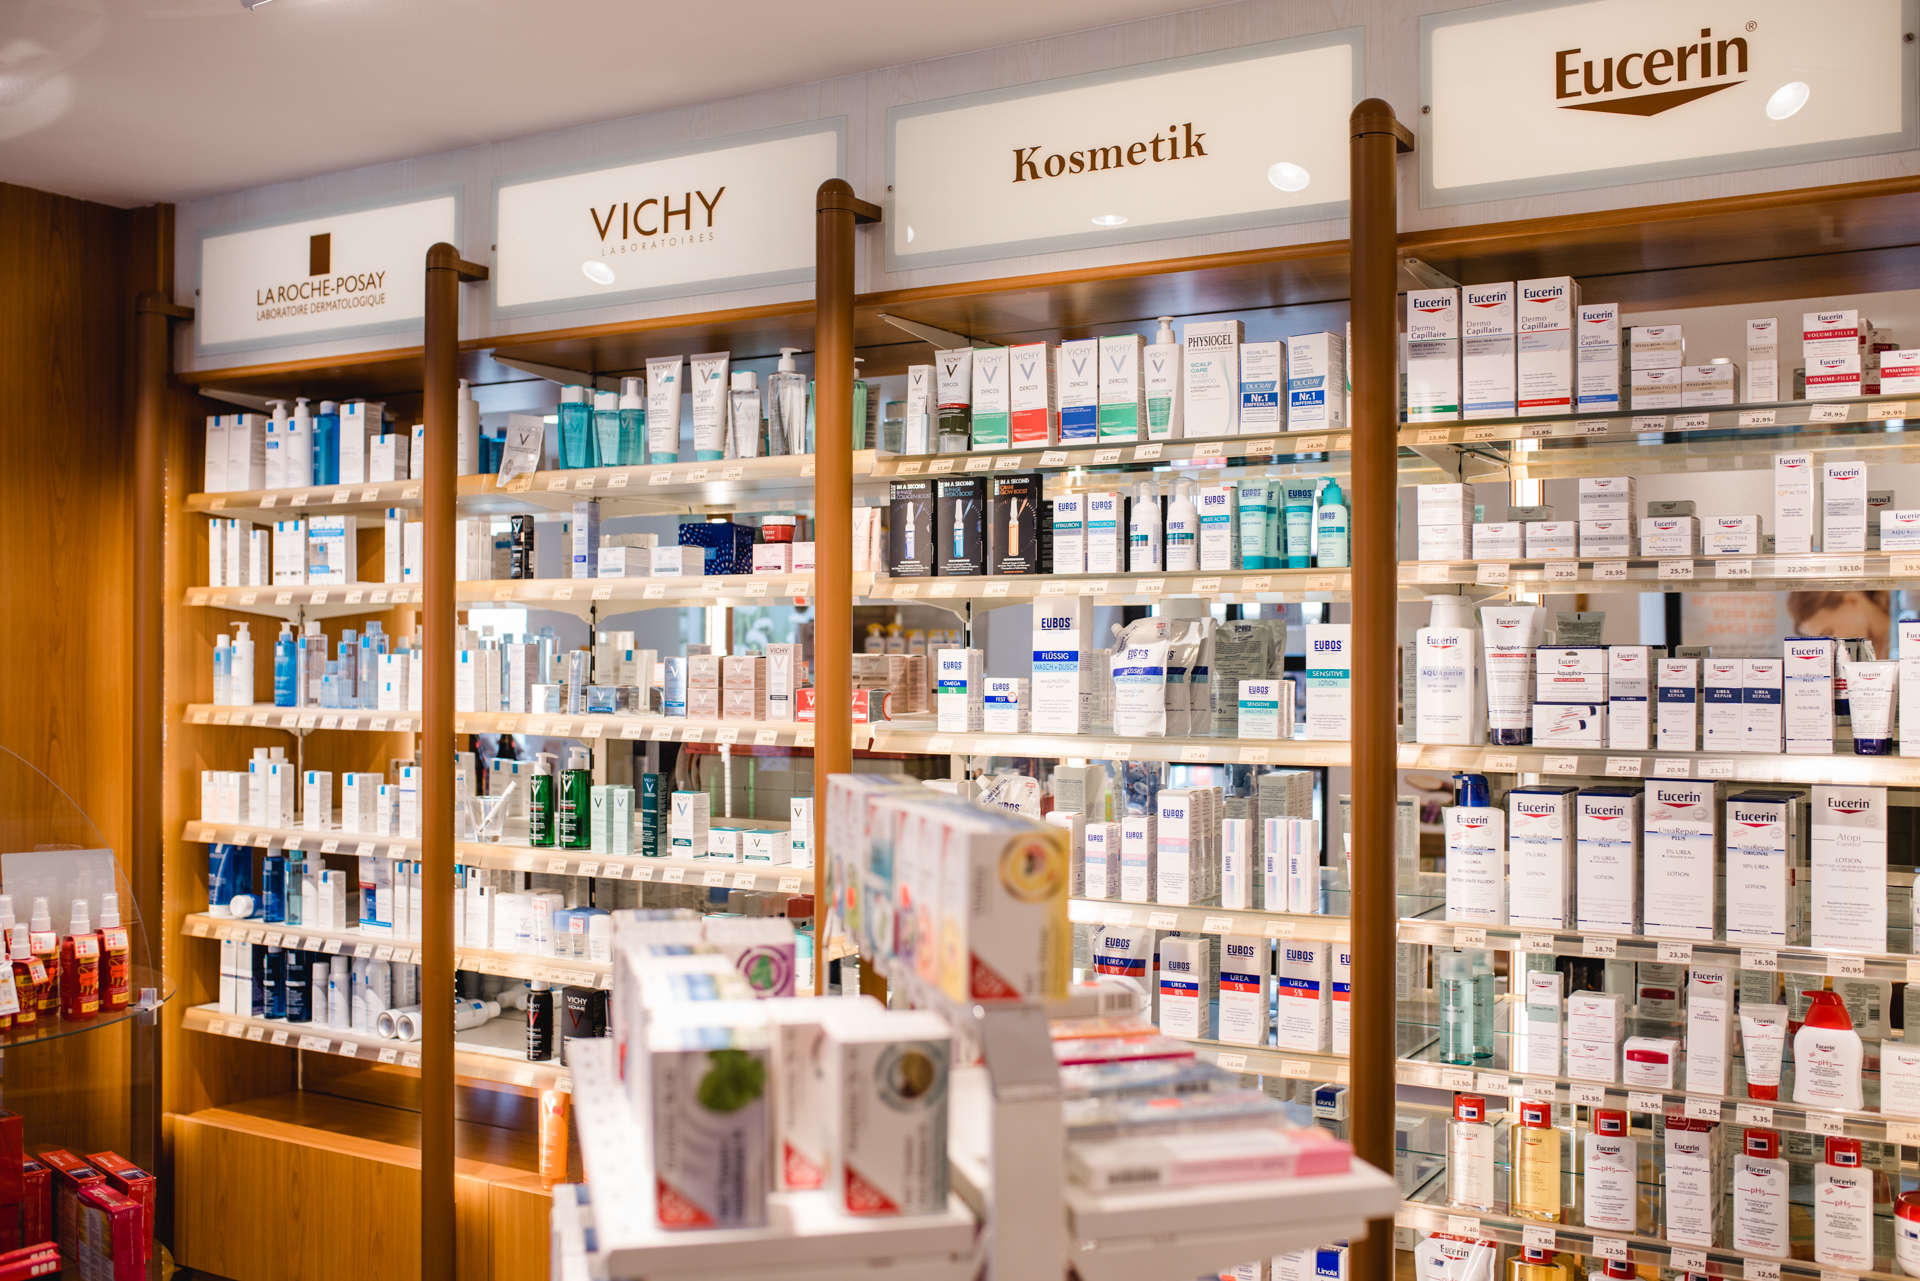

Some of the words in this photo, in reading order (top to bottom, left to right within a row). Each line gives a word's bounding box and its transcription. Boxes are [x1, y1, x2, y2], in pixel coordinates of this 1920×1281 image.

[1012, 122, 1208, 184] Kosmetik
[590, 186, 727, 243] VICHY
[601, 232, 715, 257] LABORATOIRES
[256, 290, 275, 306] LA
[277, 270, 386, 302] ROCHE-POSAY
[1524, 287, 1563, 298] Eucerin
[1414, 296, 1451, 308] Eucerin
[1469, 292, 1507, 304] Eucerin
[256, 305, 309, 321] LABORATOIRE
[310, 292, 386, 316] DERMATOLOGIQUE
[1583, 311, 1612, 320] Eucerin
[1467, 326, 1502, 335] Capillaire
[1522, 321, 1558, 331] Capillaire
[1411, 331, 1446, 340] Capillaire
[1188, 334, 1233, 347] PHYSIOGEL
[1067, 348, 1092, 356] VICHY
[1105, 344, 1132, 353] VICHY
[978, 356, 1003, 364] VICHY
[1015, 352, 1040, 360] VICHY
[1245, 382, 1272, 391] DUCRAY
[1293, 378, 1320, 387] DUCRAY
[1251, 393, 1269, 403] Nr.1
[1299, 392, 1315, 401] Nr.1
[1779, 457, 1806, 465] Eucerin
[1829, 468, 1859, 477] Eucerin
[1242, 489, 1262, 497] EUBOS
[1288, 490, 1312, 498] EUBOS
[1205, 495, 1225, 505] EUBOS
[1058, 502, 1077, 511] EUBOS
[1092, 501, 1113, 510] EUBOS
[1320, 512, 1336, 520] EUBOS
[1718, 518, 1743, 526] Eucerin
[1041, 618, 1071, 630] EUBOS
[1496, 618, 1520, 626] Eucerin
[1427, 636, 1458, 645] Eucerin
[1314, 640, 1342, 652] EUBOS
[1042, 652, 1069, 660] FLÜSSIG
[1791, 647, 1824, 656] Eucerin
[943, 661, 962, 670] EUBOS
[1059, 663, 1078, 671] DUSCH
[992, 683, 1010, 691] EUBOS
[1248, 686, 1269, 694] EUBOS
[1657, 790, 1701, 802] Eucerin
[1517, 802, 1555, 813] Eucerin
[1828, 797, 1870, 809] Eucerin
[1163, 809, 1184, 819] EUBOS
[1585, 805, 1624, 815] Eucerin
[1456, 814, 1488, 824] Eucerin
[1735, 811, 1777, 823] Eucerin
[1126, 831, 1143, 839] EUBOS
[1658, 827, 1699, 835] UreaRepair
[1088, 834, 1104, 842] EUBOS
[1519, 834, 1552, 842] UreaRepair
[1837, 832, 1861, 843] Atopi
[1105, 937, 1131, 950] EUBOS
[1227, 945, 1254, 957] EUBOS
[1286, 949, 1314, 962] EUBOS
[1169, 961, 1190, 971] EUBOS
[1693, 972, 1724, 982] Eucerin
[1235, 983, 1244, 991] 5%
[1289, 980, 1309, 988] UREA
[1294, 988, 1304, 996] 5%
[567, 996, 587, 1005] VICHY
[1816, 1043, 1835, 1051] Eucerin
[1596, 1144, 1621, 1153] Eucerin
[1674, 1142, 1700, 1151] Eucerin
[1746, 1164, 1771, 1174] Eucerin
[1829, 1176, 1856, 1186] Eucerin
